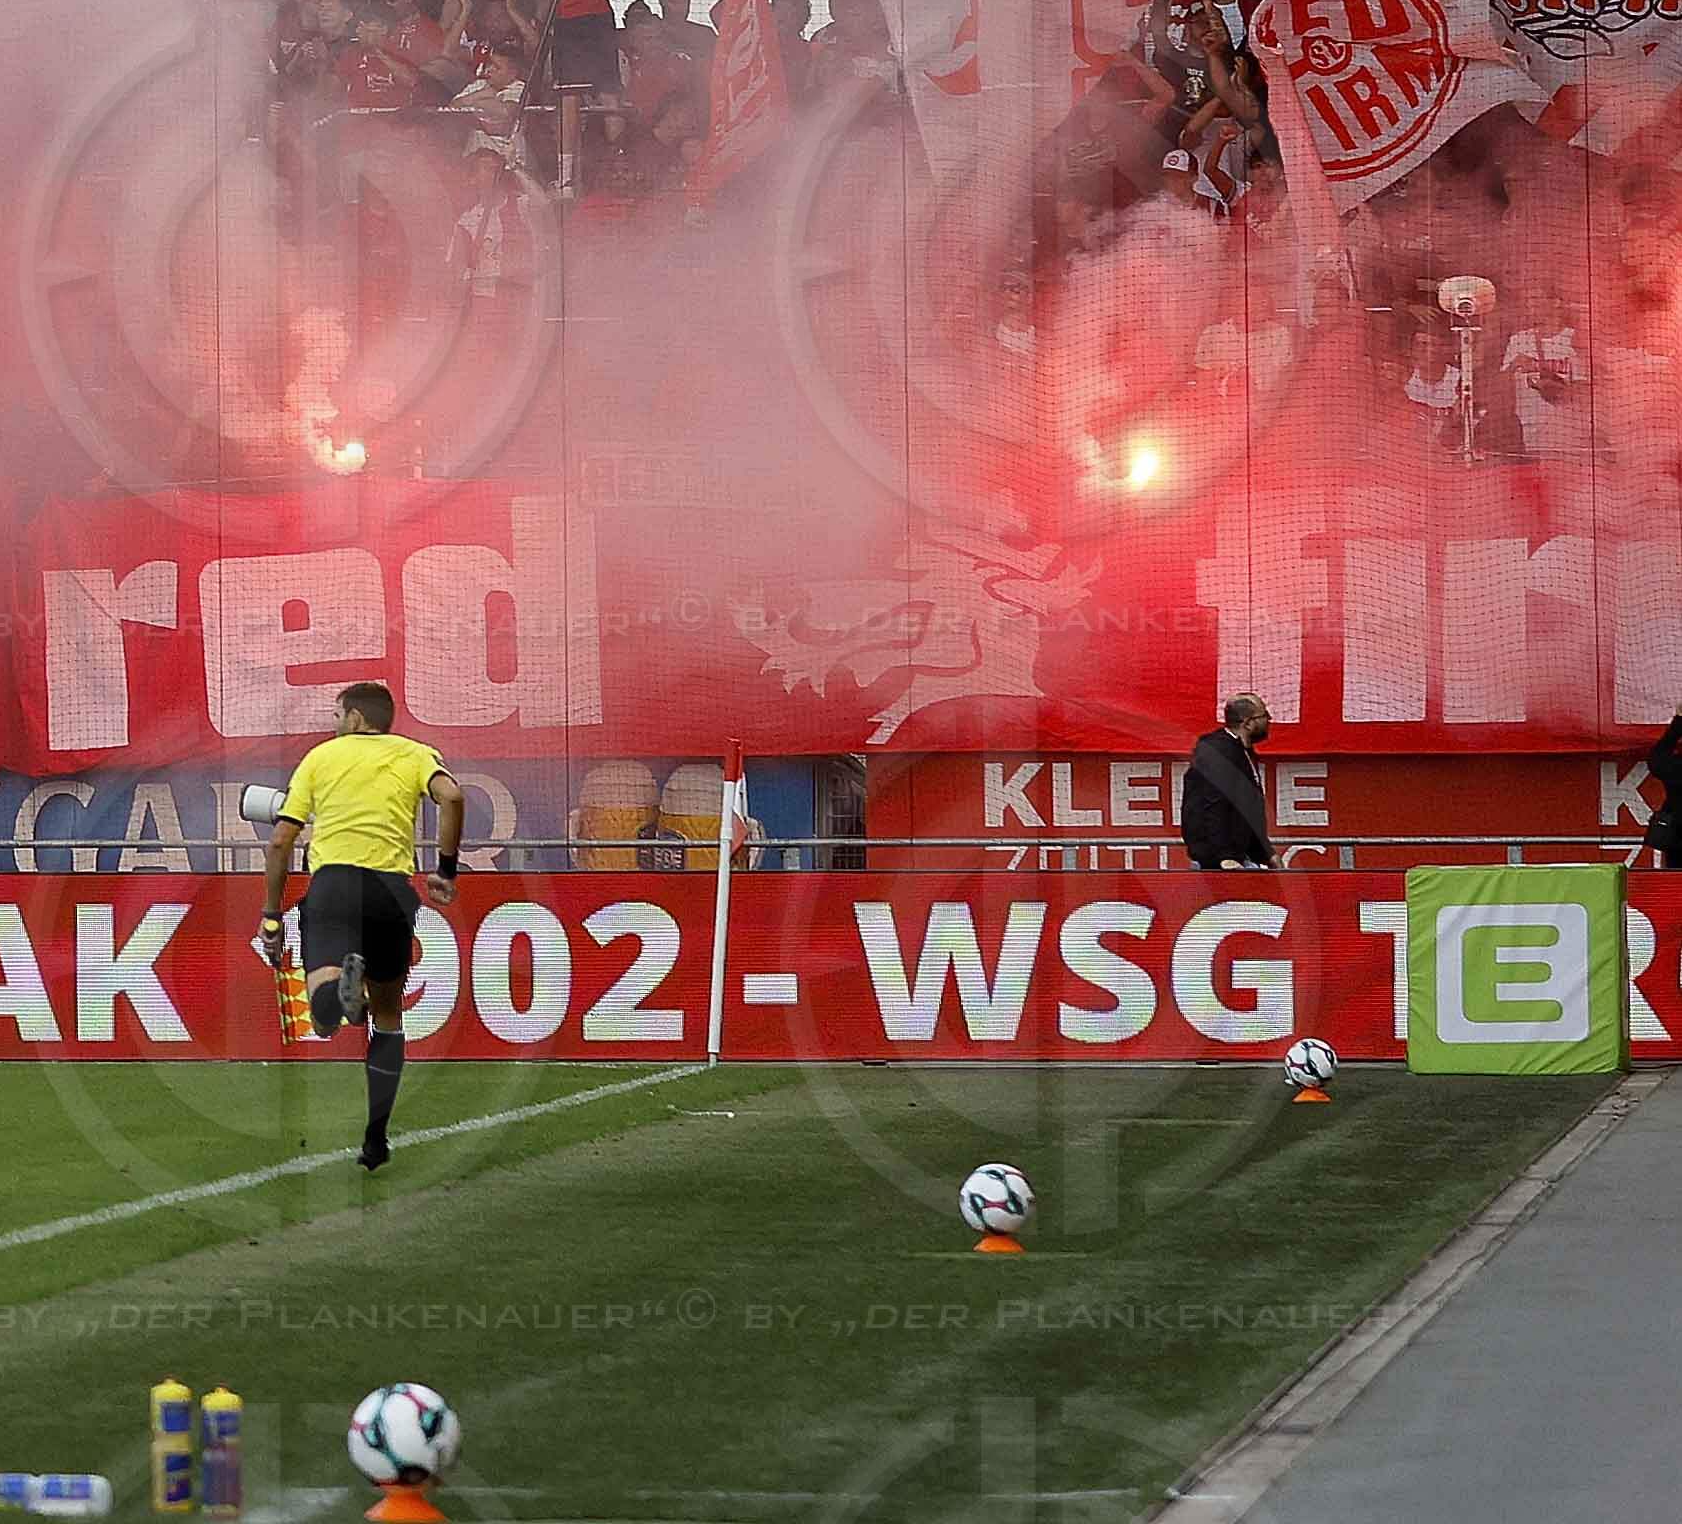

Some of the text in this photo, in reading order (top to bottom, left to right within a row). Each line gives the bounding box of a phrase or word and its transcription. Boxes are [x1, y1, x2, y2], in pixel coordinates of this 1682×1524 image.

[44, 496, 603, 752] red
[984, 762, 1328, 828] KLEIE
[281, 901, 685, 1043] 902
[856, 900, 1289, 1044] WSG
